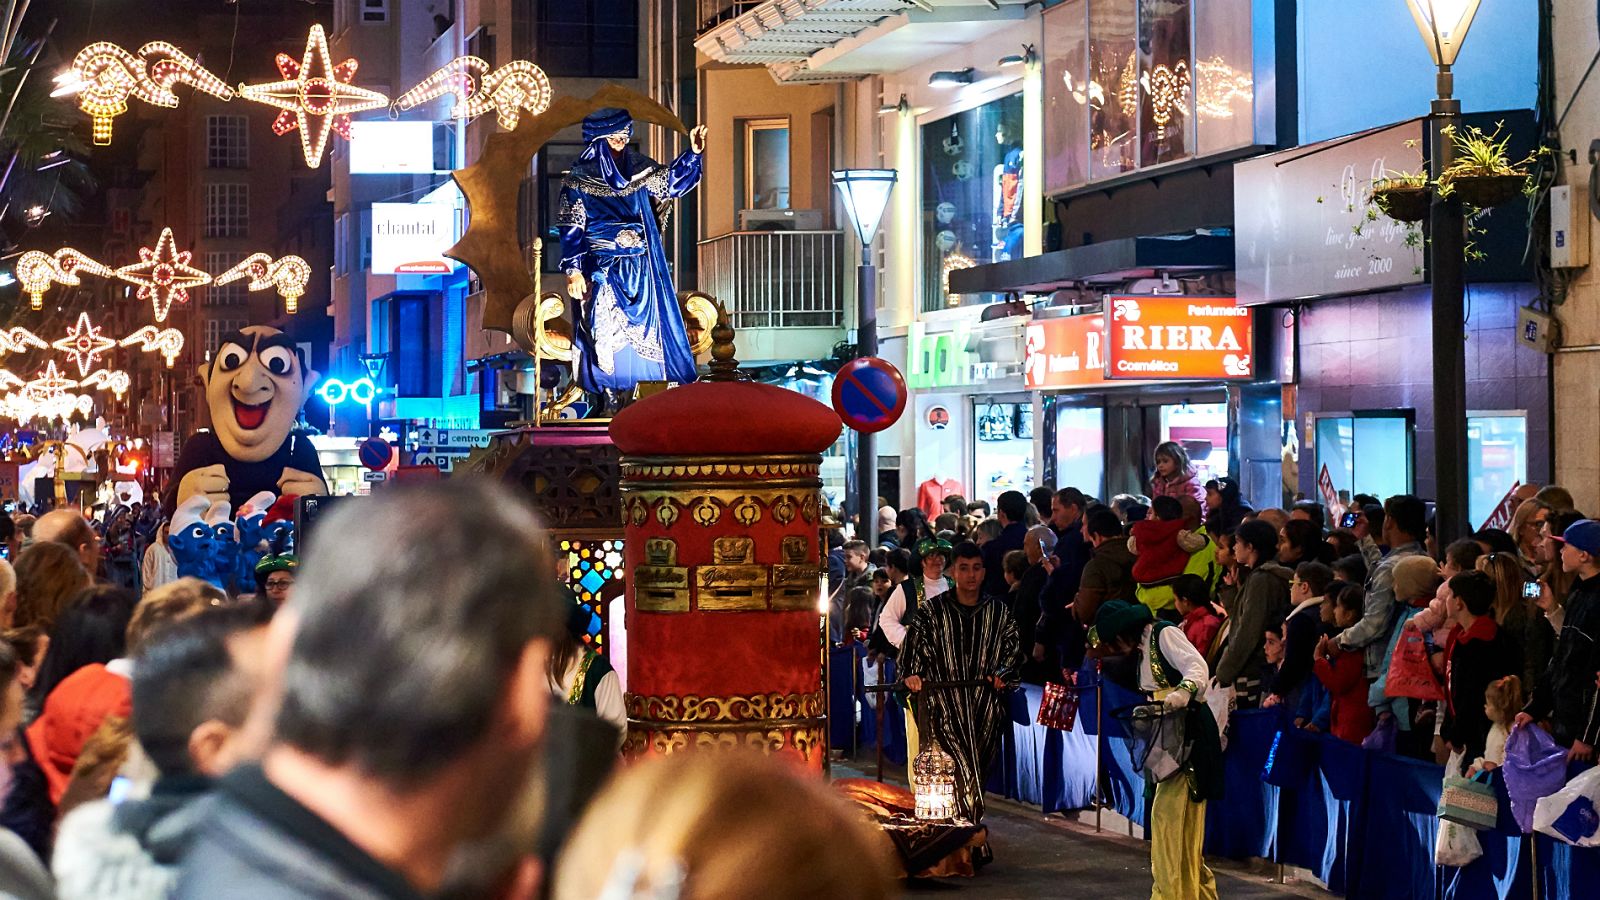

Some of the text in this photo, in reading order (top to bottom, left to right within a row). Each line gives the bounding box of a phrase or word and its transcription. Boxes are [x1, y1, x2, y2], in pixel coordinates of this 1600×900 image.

[377, 219, 435, 235] chantal
[1325, 226, 1344, 246] live
[1345, 227, 1375, 249] your
[1334, 257, 1393, 279] since 2000
[1121, 325, 1243, 351] RIERA
[1085, 331, 1104, 370] R
[1117, 360, 1179, 372] Cosmética
[451, 434, 479, 443] centro
